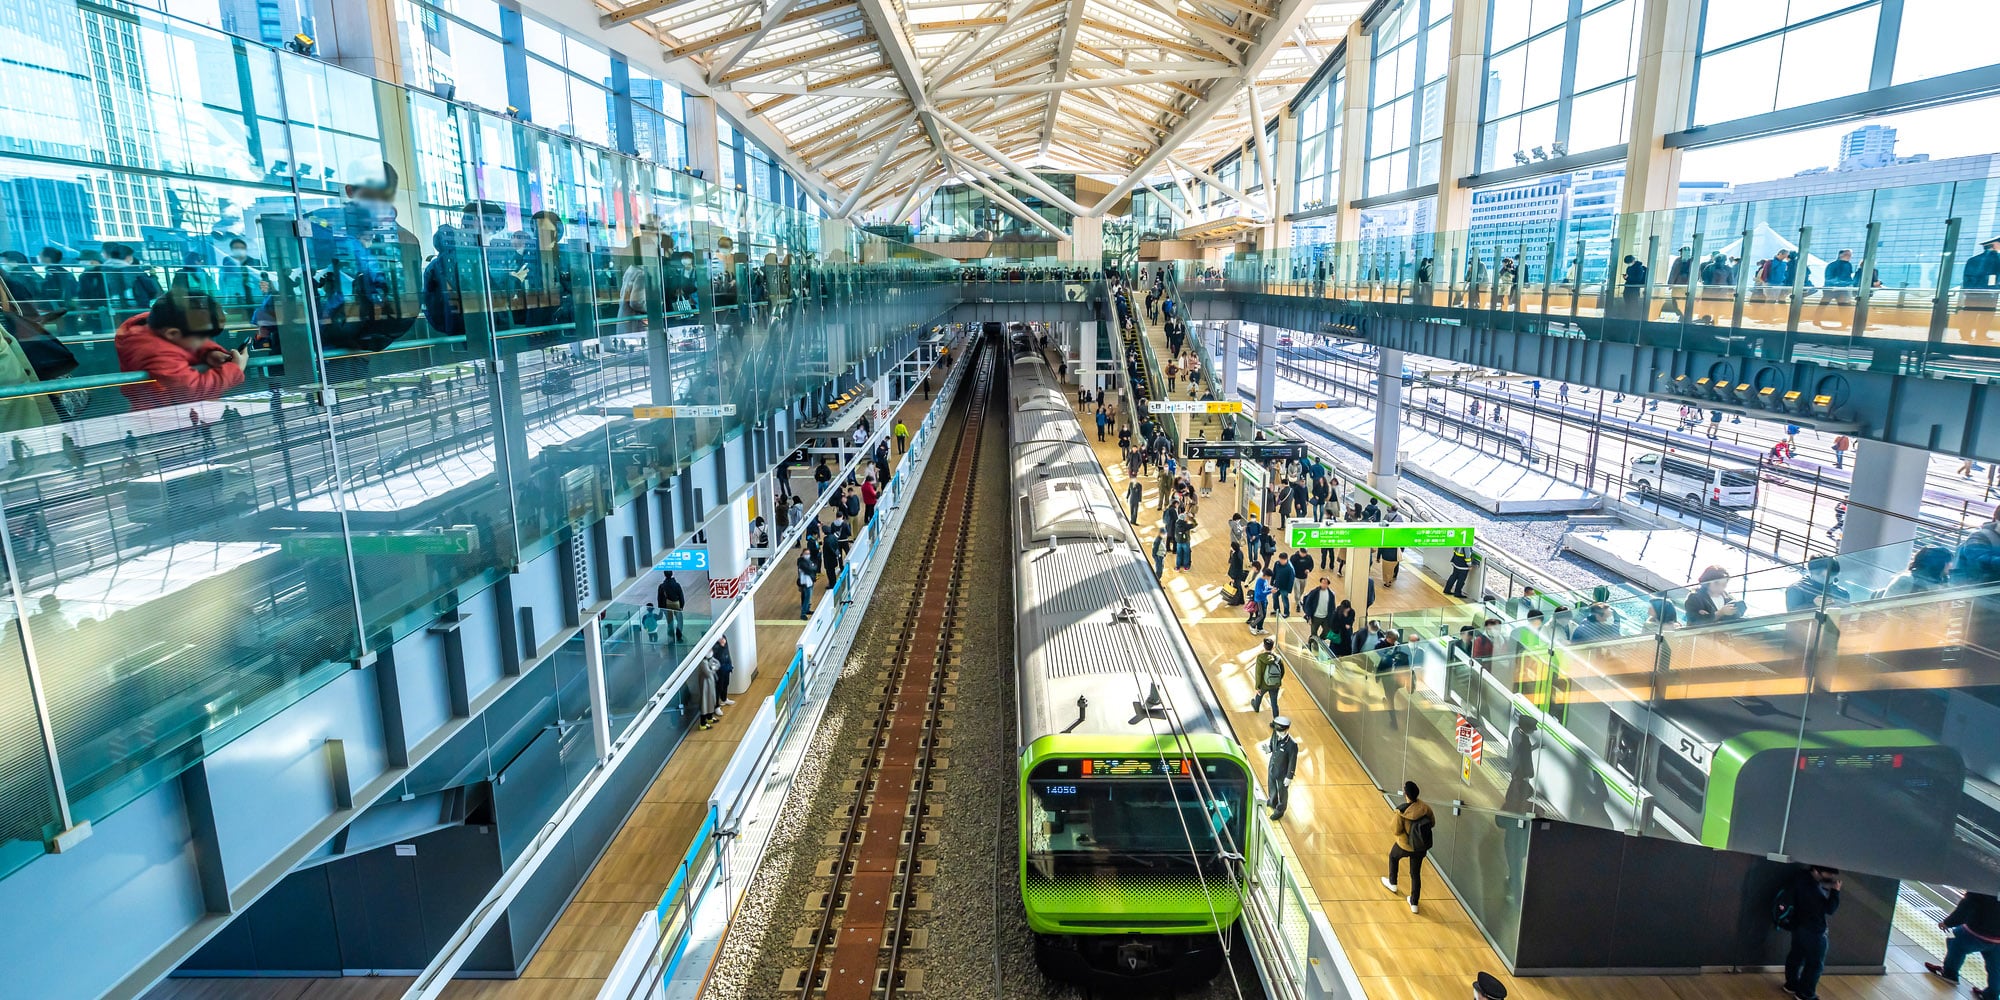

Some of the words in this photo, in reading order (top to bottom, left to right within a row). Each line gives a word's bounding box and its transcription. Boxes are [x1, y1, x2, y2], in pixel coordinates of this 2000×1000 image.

[796, 450, 803, 460] 3
[1192, 447, 1200, 459] 2
[1297, 447, 1303, 458] 1
[1296, 530, 1307, 546] 2
[1460, 530, 1467, 545] 1
[695, 552, 706, 568] 3
[1046, 786, 1077, 794] 1405G
